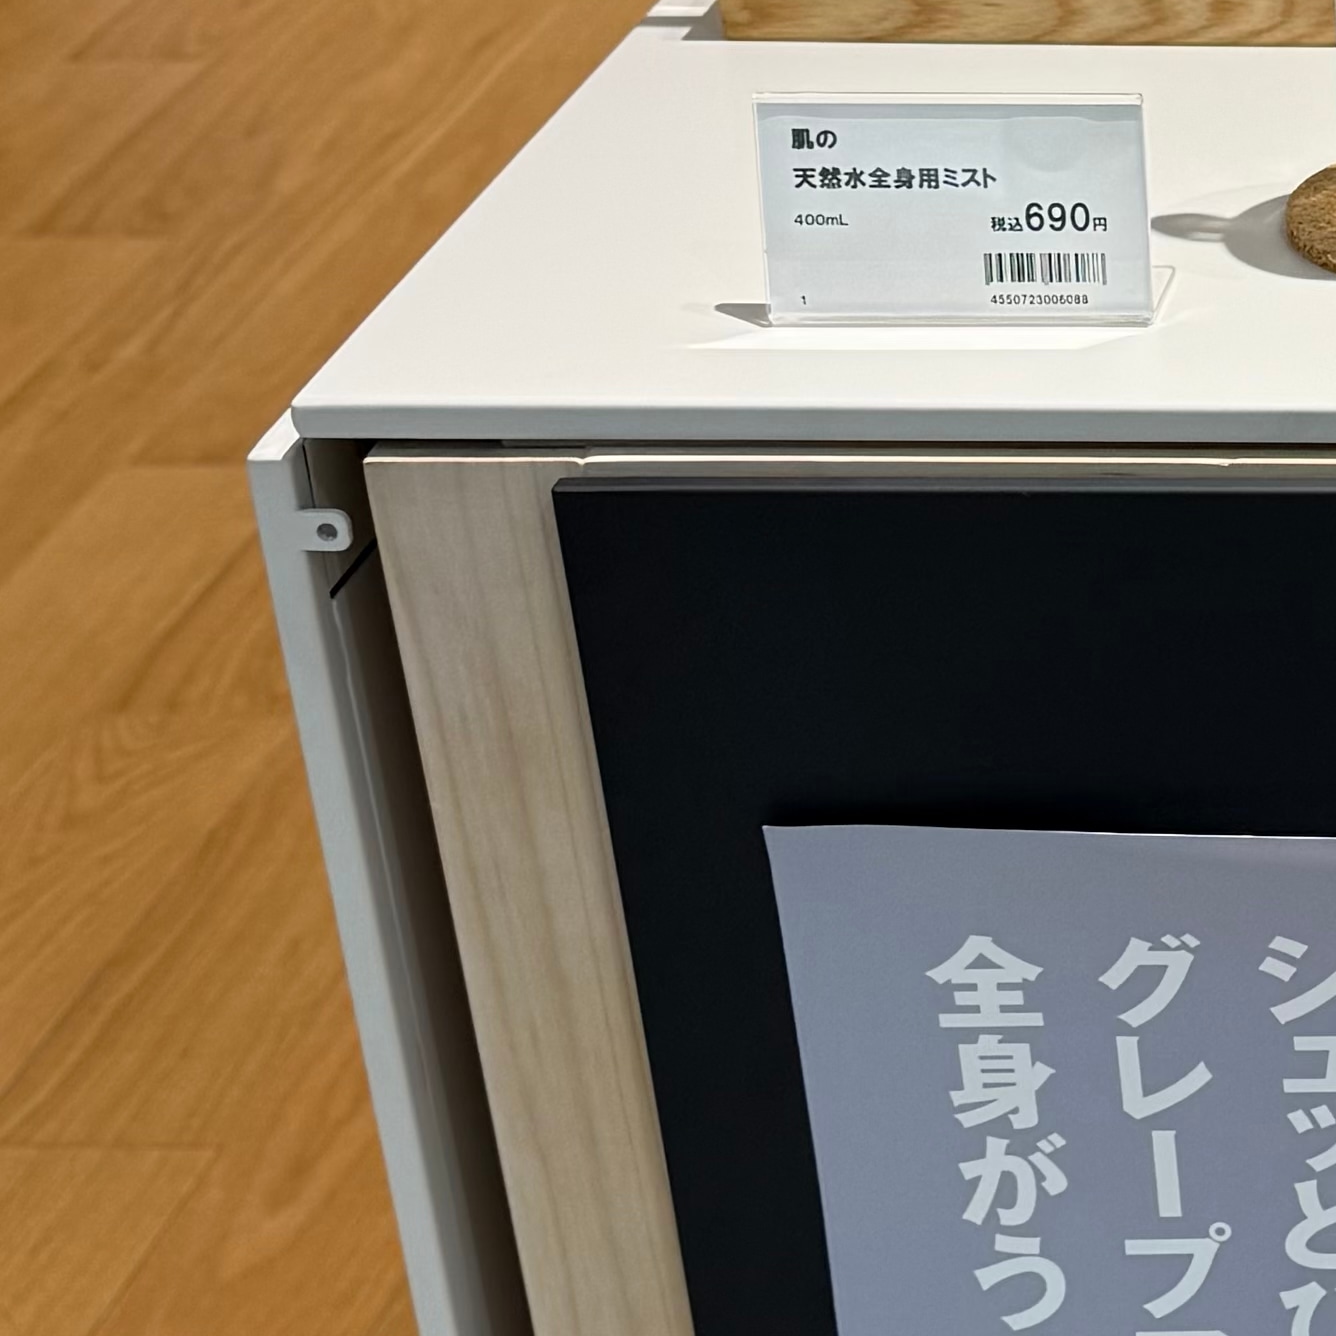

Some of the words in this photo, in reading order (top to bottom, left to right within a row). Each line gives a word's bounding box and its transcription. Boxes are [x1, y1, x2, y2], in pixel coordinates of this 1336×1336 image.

[791, 128, 838, 150] 肌の
[794, 167, 998, 190] 天然水全身用ミスト
[794, 213, 849, 226] 400mL
[990, 202, 1108, 232] 税込690円
